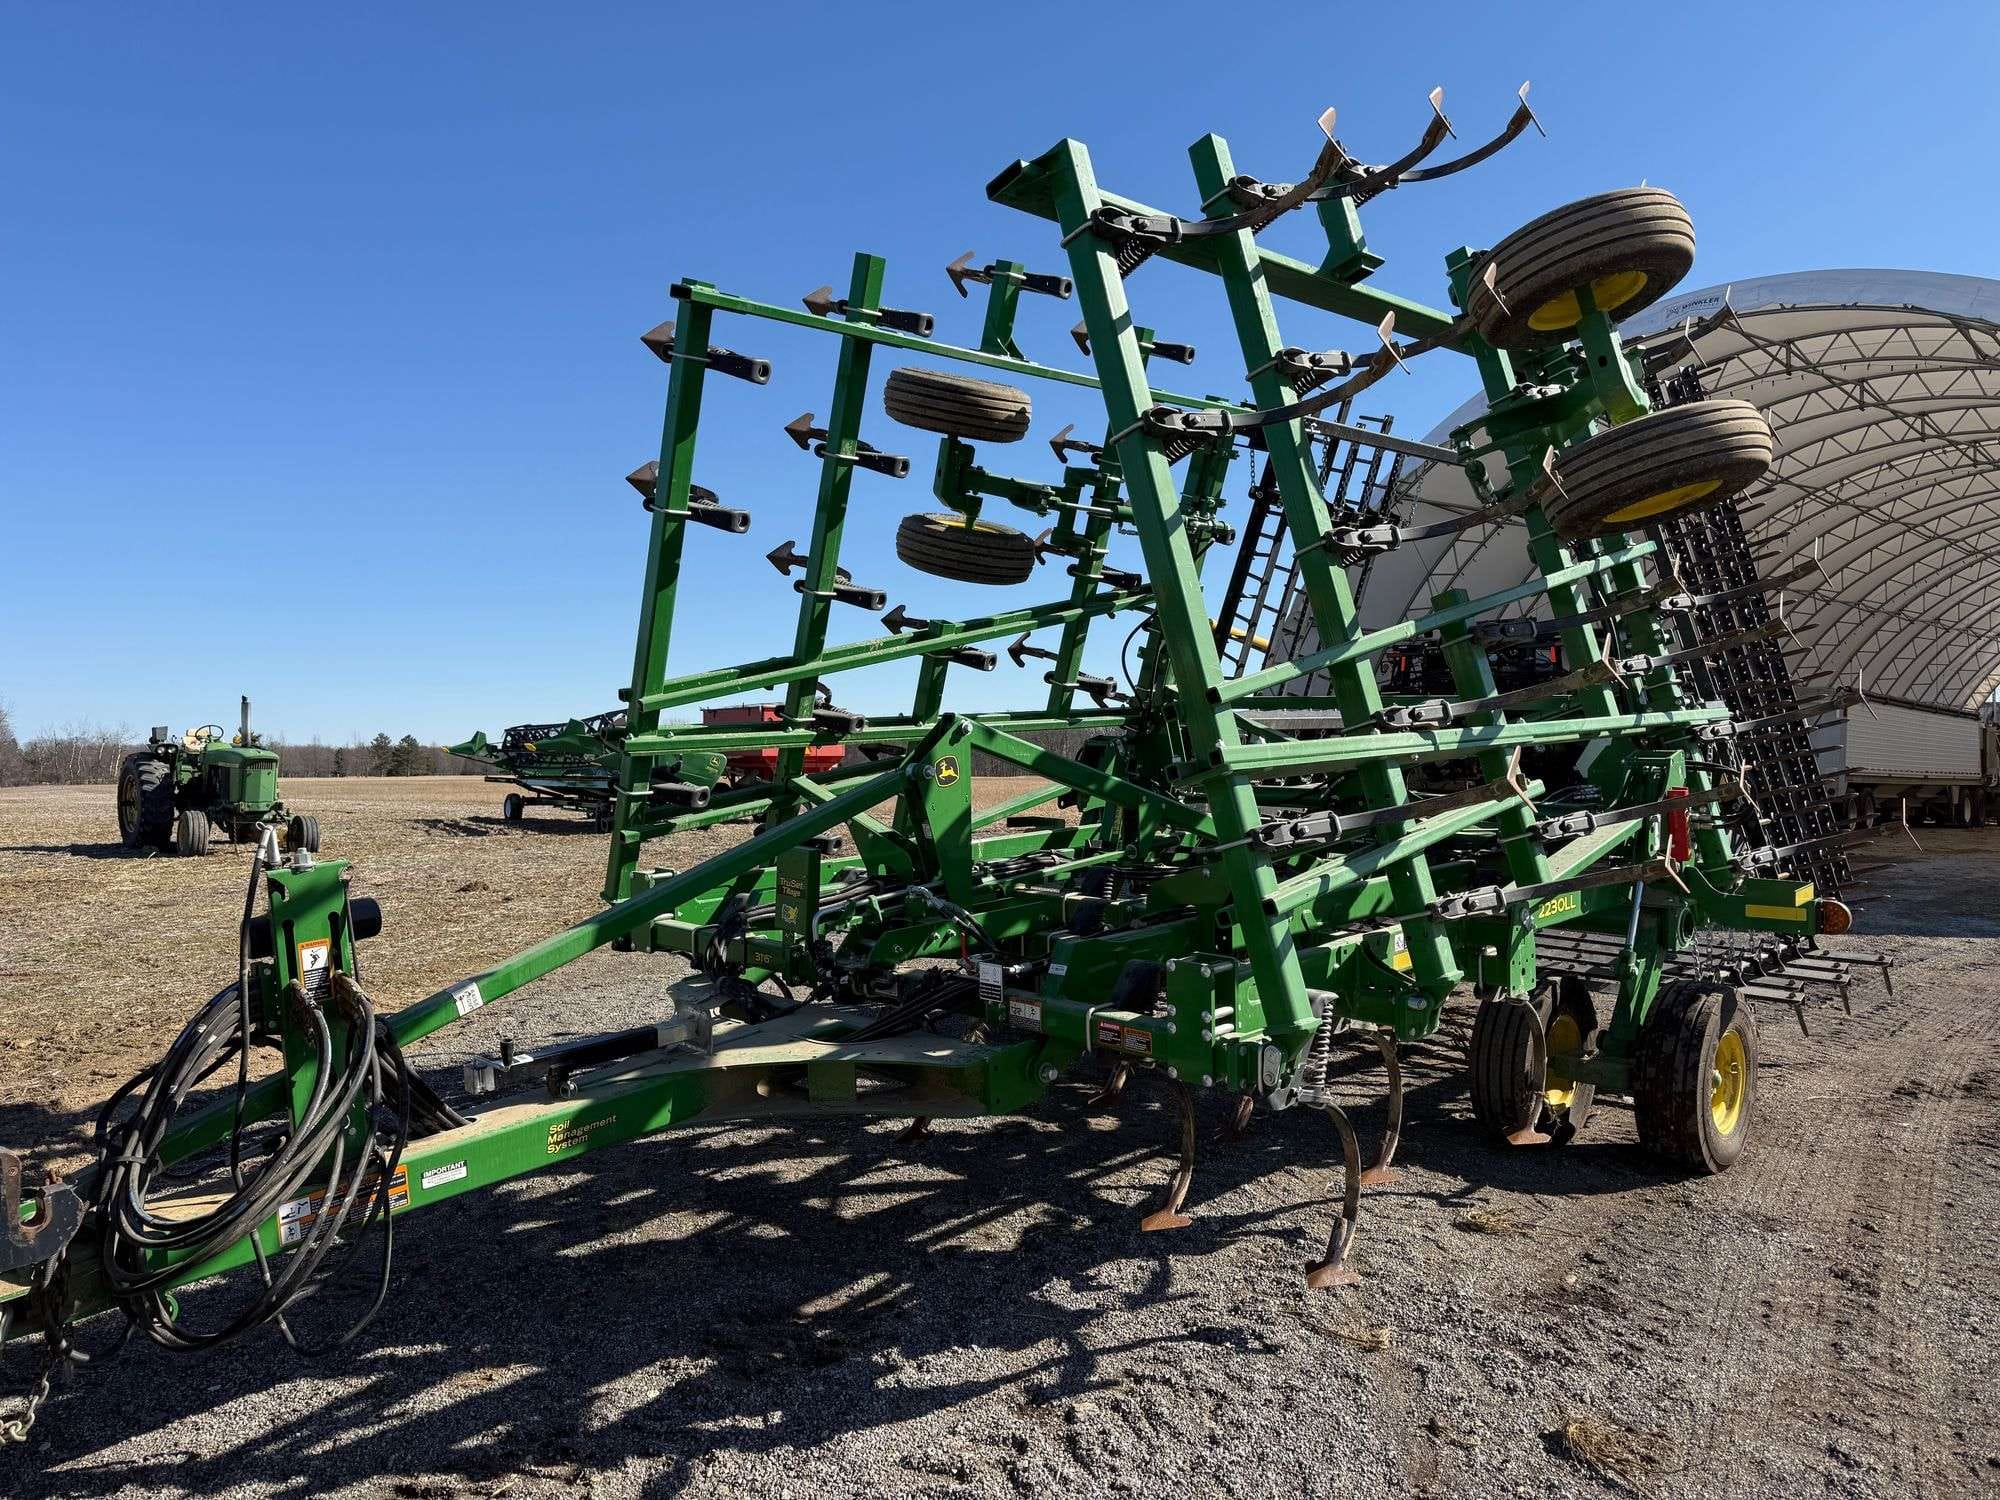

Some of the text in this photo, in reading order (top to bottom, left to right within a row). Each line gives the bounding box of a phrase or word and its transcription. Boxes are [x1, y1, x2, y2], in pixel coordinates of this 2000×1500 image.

[1539, 895, 1576, 918] 2230LL
[547, 1115, 617, 1145] Management
[549, 1120, 570, 1134] Soil
[547, 1134, 588, 1153] System
[423, 1160, 465, 1178] IMPORTANT
